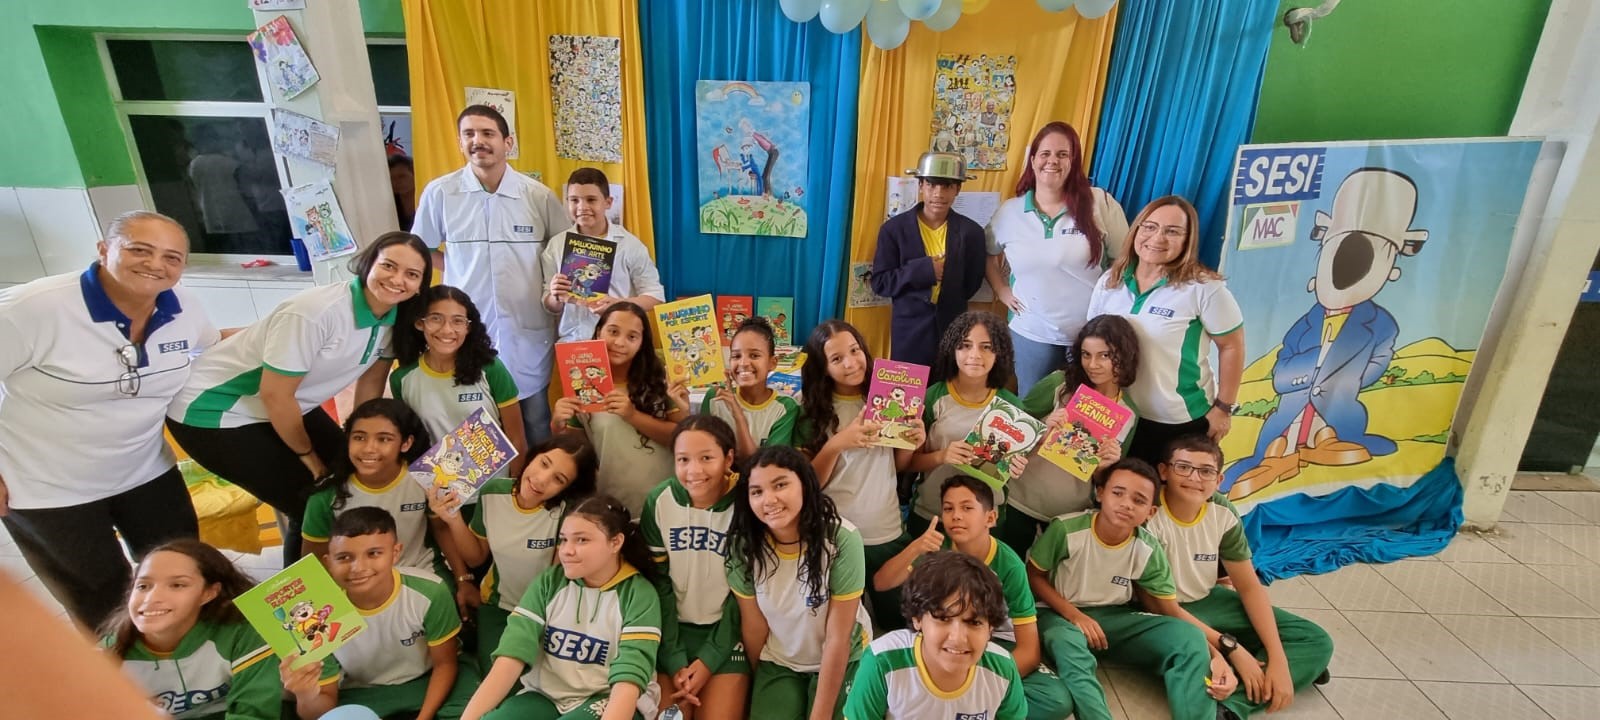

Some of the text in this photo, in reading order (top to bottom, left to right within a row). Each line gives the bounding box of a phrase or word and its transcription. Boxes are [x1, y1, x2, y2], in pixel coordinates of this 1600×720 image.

[1245, 154, 1319, 197] SESI
[1253, 216, 1285, 240] MAC
[568, 239, 613, 254] MALUQUINHO
[572, 247, 587, 255] POR
[1151, 306, 1171, 317] SESI
[163, 341, 185, 352] SESI
[877, 367, 922, 386] Carolina
[460, 393, 481, 402] SESI
[1075, 400, 1116, 429] MENINA
[470, 432, 490, 460] MUITO
[473, 421, 499, 457] VIAGENS
[403, 503, 425, 511] SES
[530, 539, 551, 549] SESI
[677, 529, 728, 554] SESI
[548, 631, 601, 661] SESI
